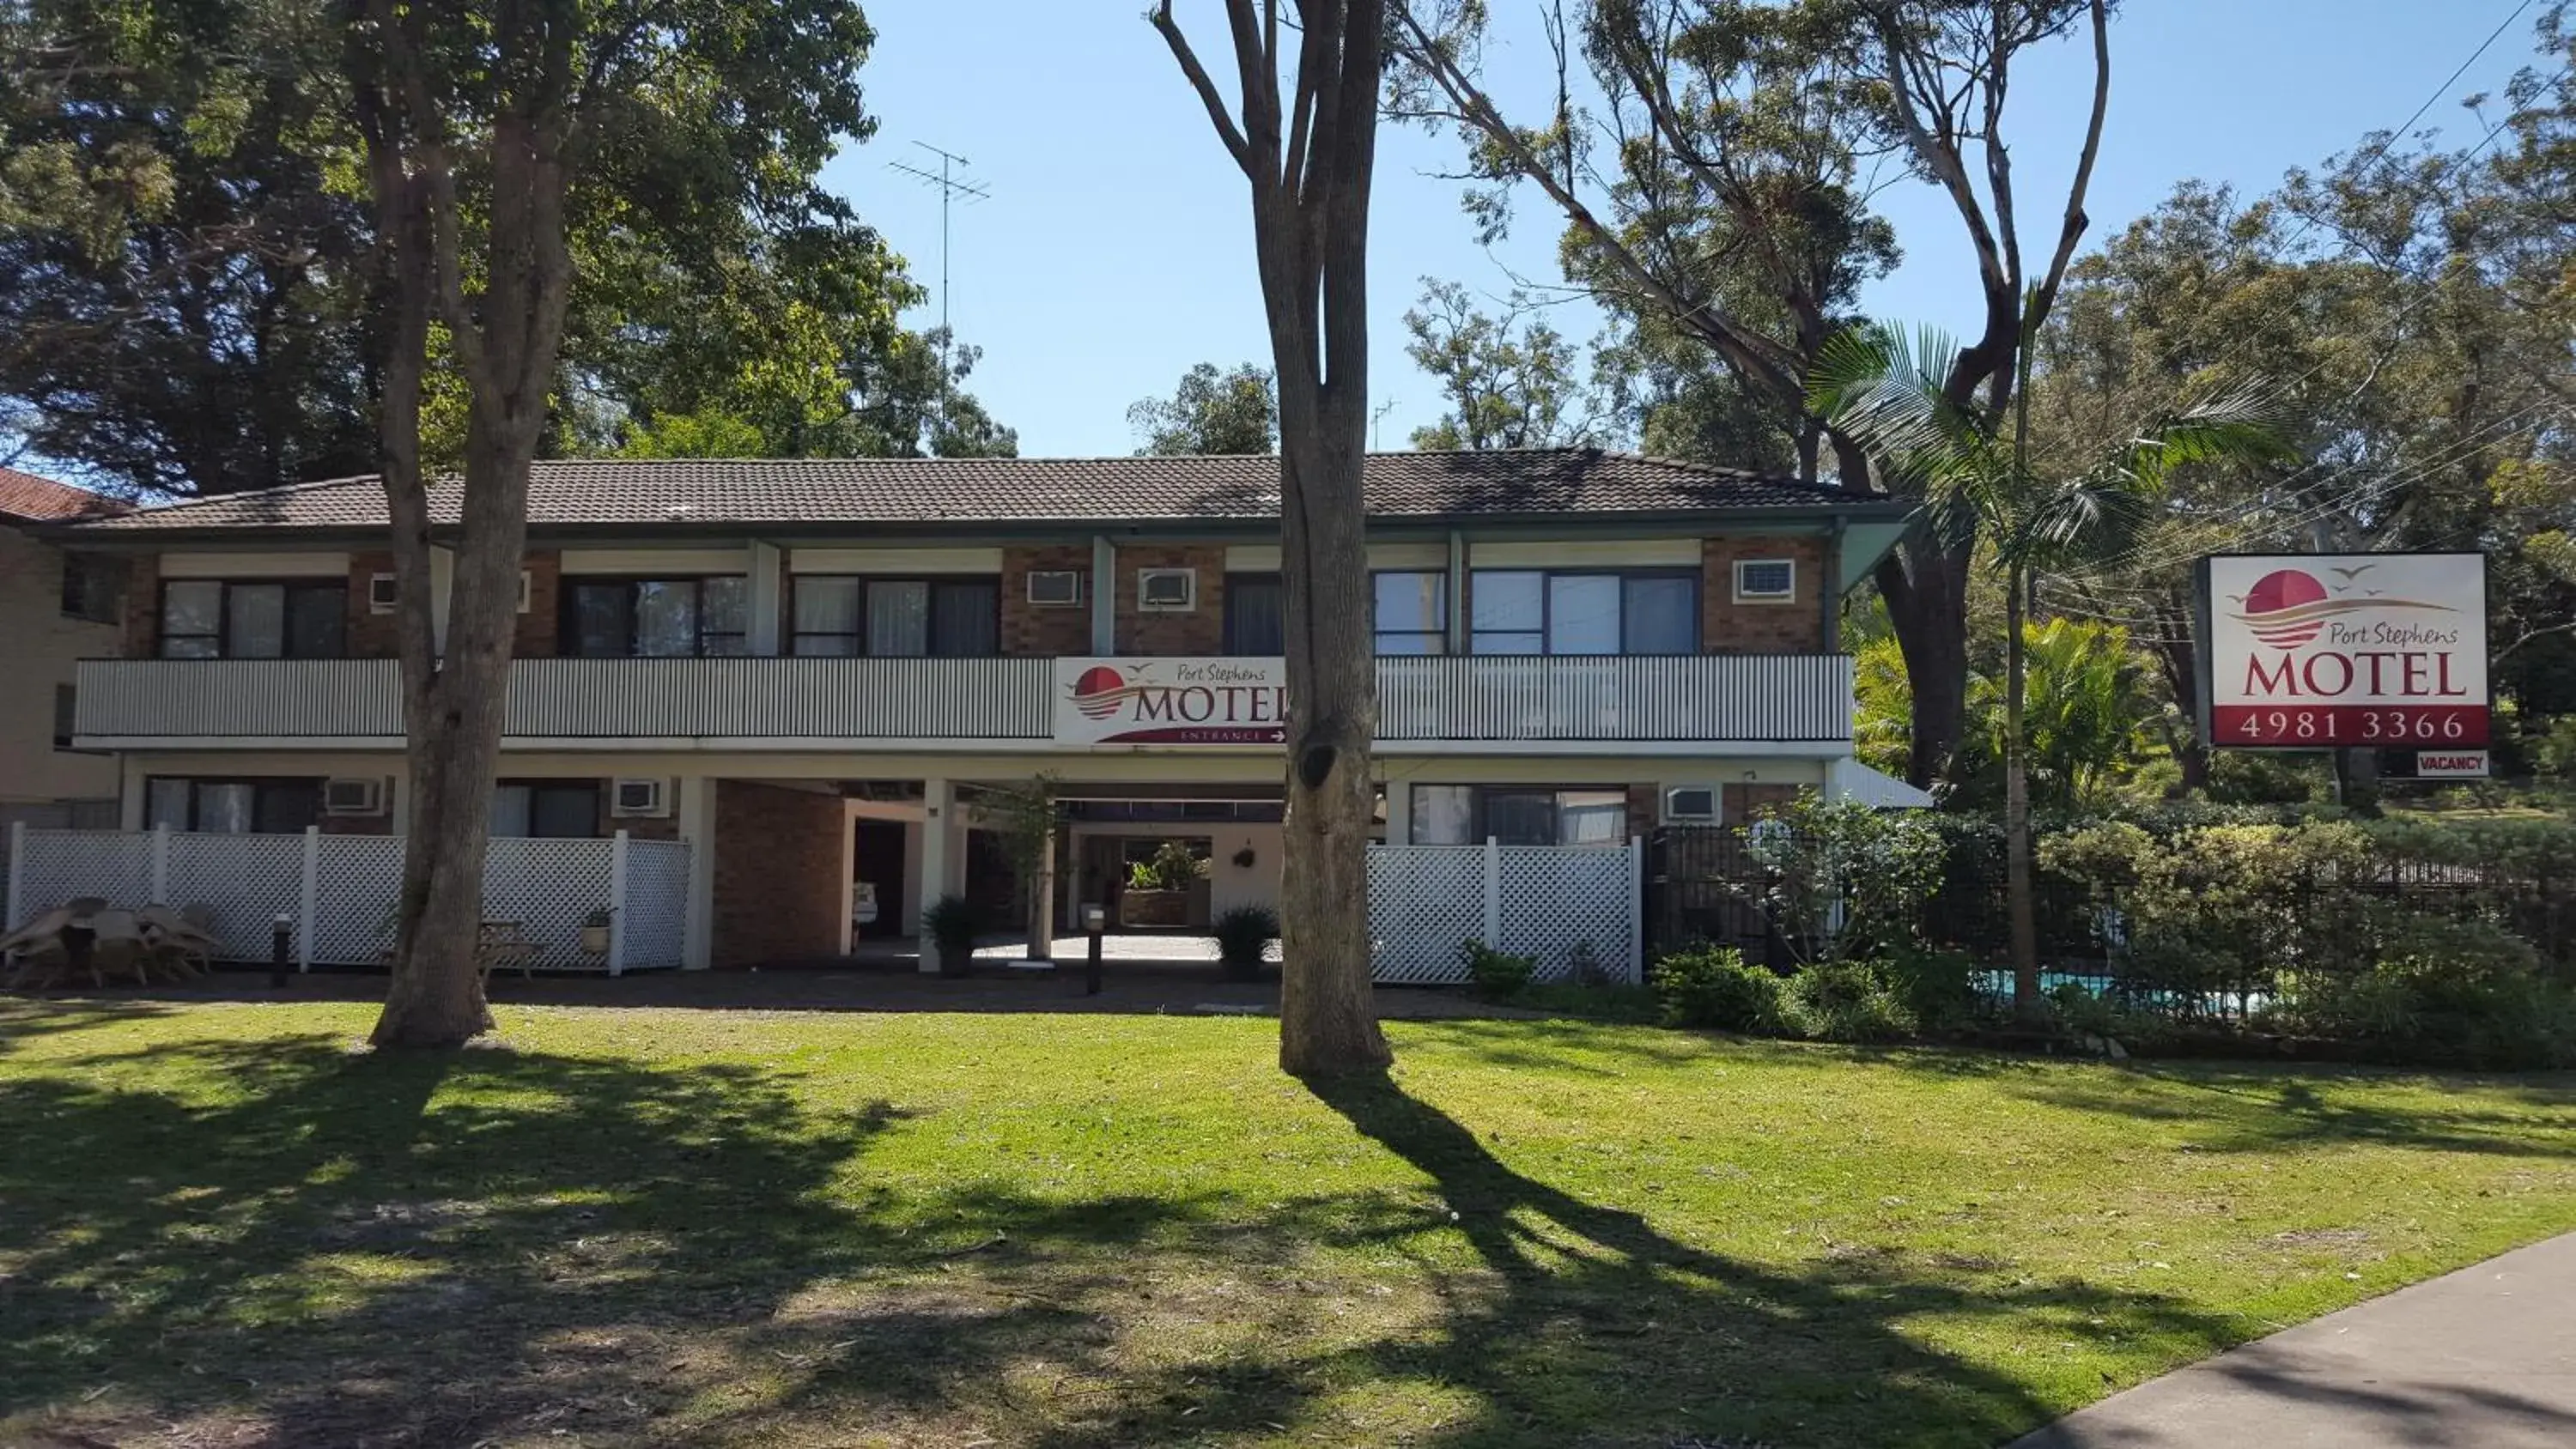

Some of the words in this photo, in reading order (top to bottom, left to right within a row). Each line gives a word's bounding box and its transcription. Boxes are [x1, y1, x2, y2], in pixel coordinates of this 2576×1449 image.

[2329, 621, 2368, 645] Port
[2373, 621, 2458, 647] Stephens
[1176, 664, 1204, 681] Port
[1207, 663, 1266, 683] Stephens
[2240, 652, 2467, 696] MOTEL
[1180, 731, 1260, 742] ENTRANCE
[2239, 712, 2337, 738] 4981
[2361, 712, 2464, 739] 3366
[2420, 756, 2483, 770] VACANCY
